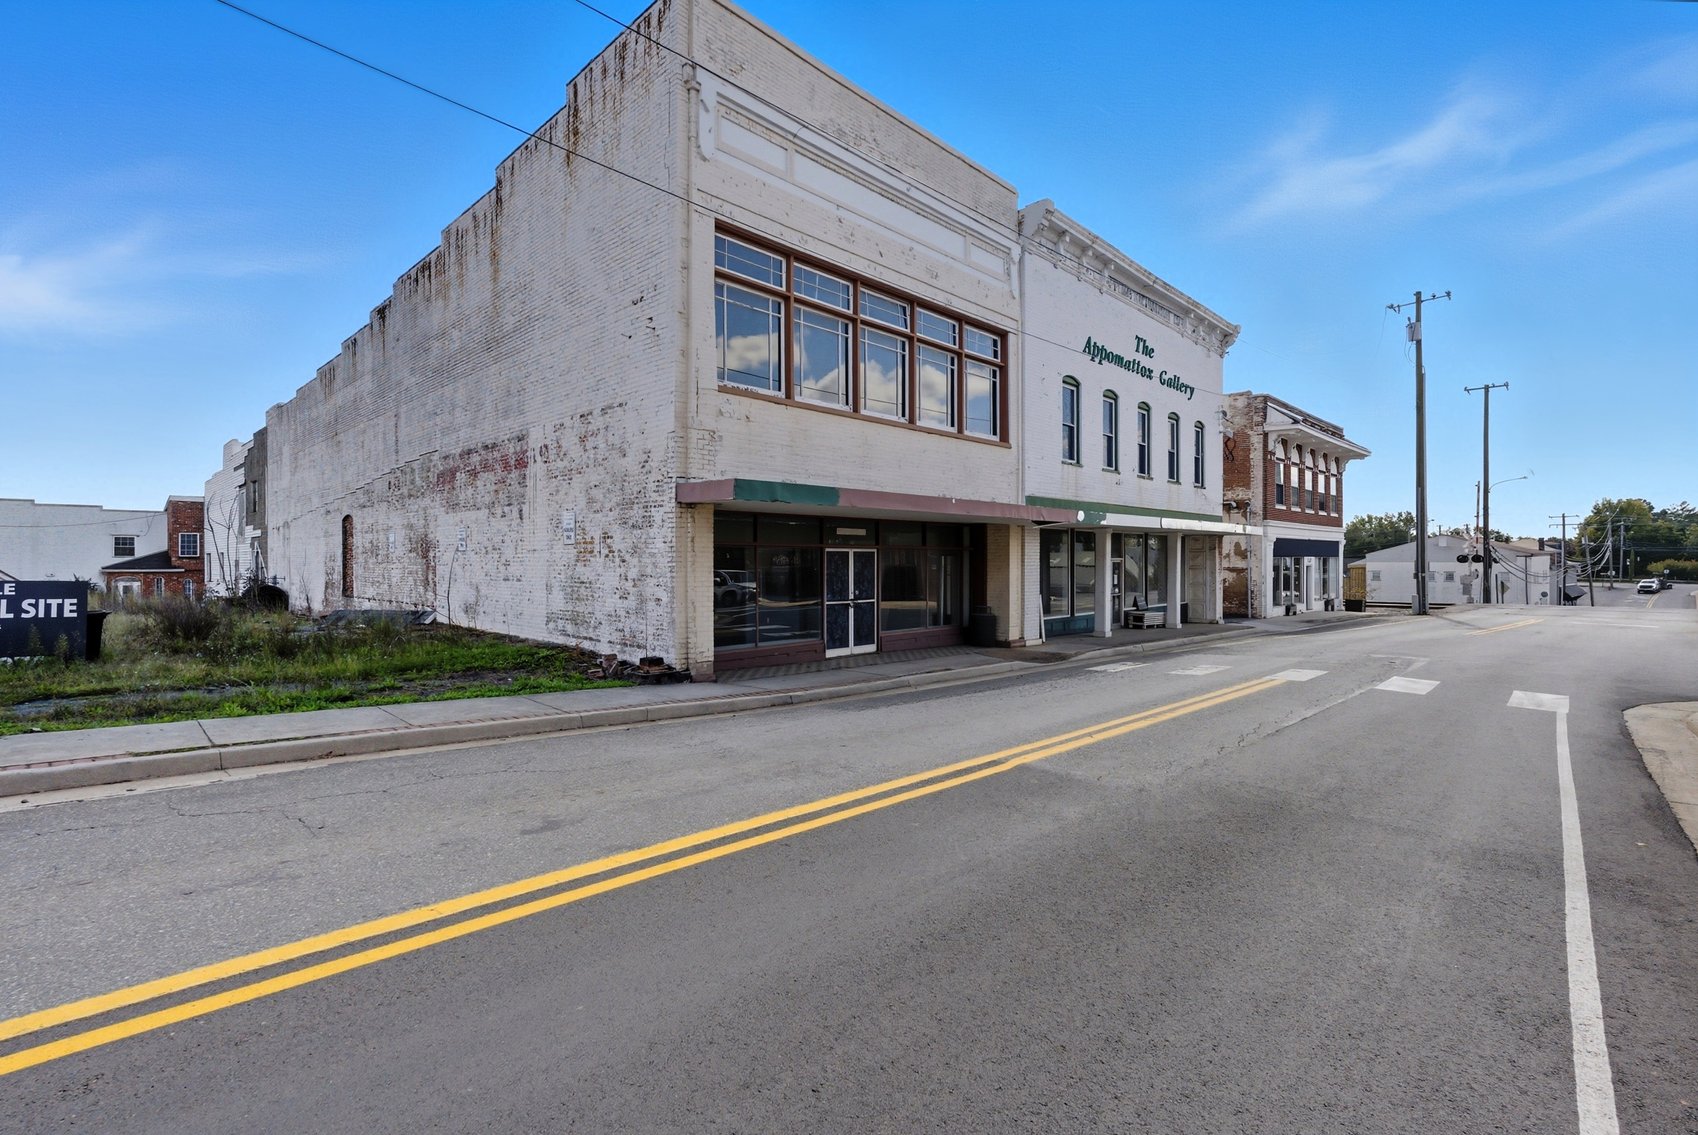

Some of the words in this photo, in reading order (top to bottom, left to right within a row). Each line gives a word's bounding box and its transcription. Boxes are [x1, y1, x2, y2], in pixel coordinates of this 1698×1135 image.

[1134, 334, 1155, 359] The
[1082, 336, 1154, 380] Appomattox
[1159, 370, 1195, 400] Gallery
[21, 598, 78, 618] SITE
